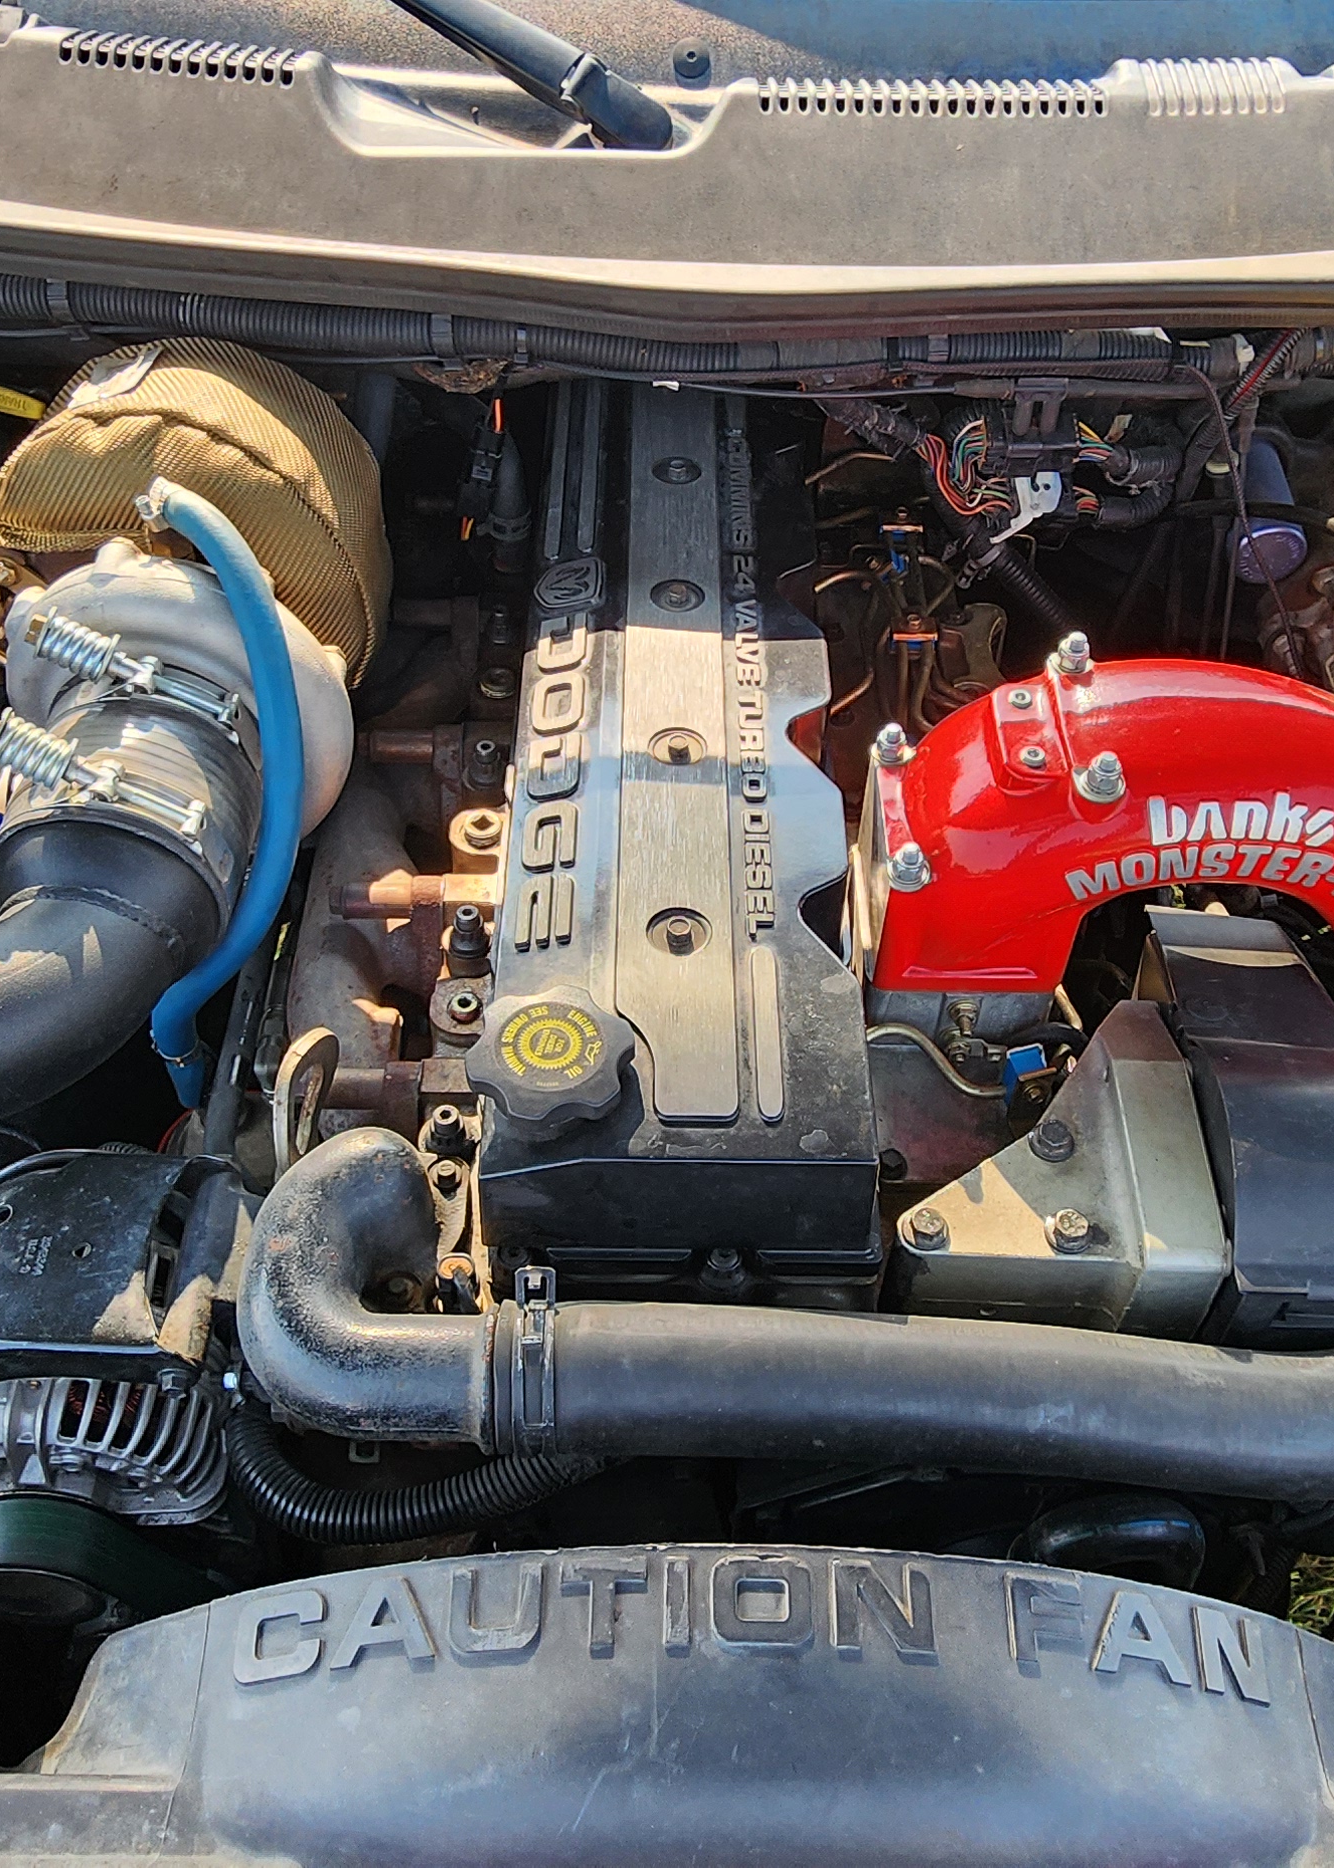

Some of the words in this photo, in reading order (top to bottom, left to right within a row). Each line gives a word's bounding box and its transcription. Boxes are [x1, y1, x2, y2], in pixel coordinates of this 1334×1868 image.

[728, 437, 754, 550] CUMMINS
[733, 555, 755, 595] 24
[735, 600, 762, 687] VALVE
[738, 695, 769, 803] TURBO
[514, 612, 588, 953] DODGE
[742, 808, 776, 942] DIESEL
[501, 1013, 529, 1043] OWNERS
[528, 1005, 549, 1018] SEE
[567, 1009, 598, 1038] ENGINE
[500, 1045, 527, 1077] MANUAL
[564, 1065, 583, 1079] OIL
[231, 1553, 939, 1688] CAUTION
[1002, 1570, 1272, 1708] FAN
